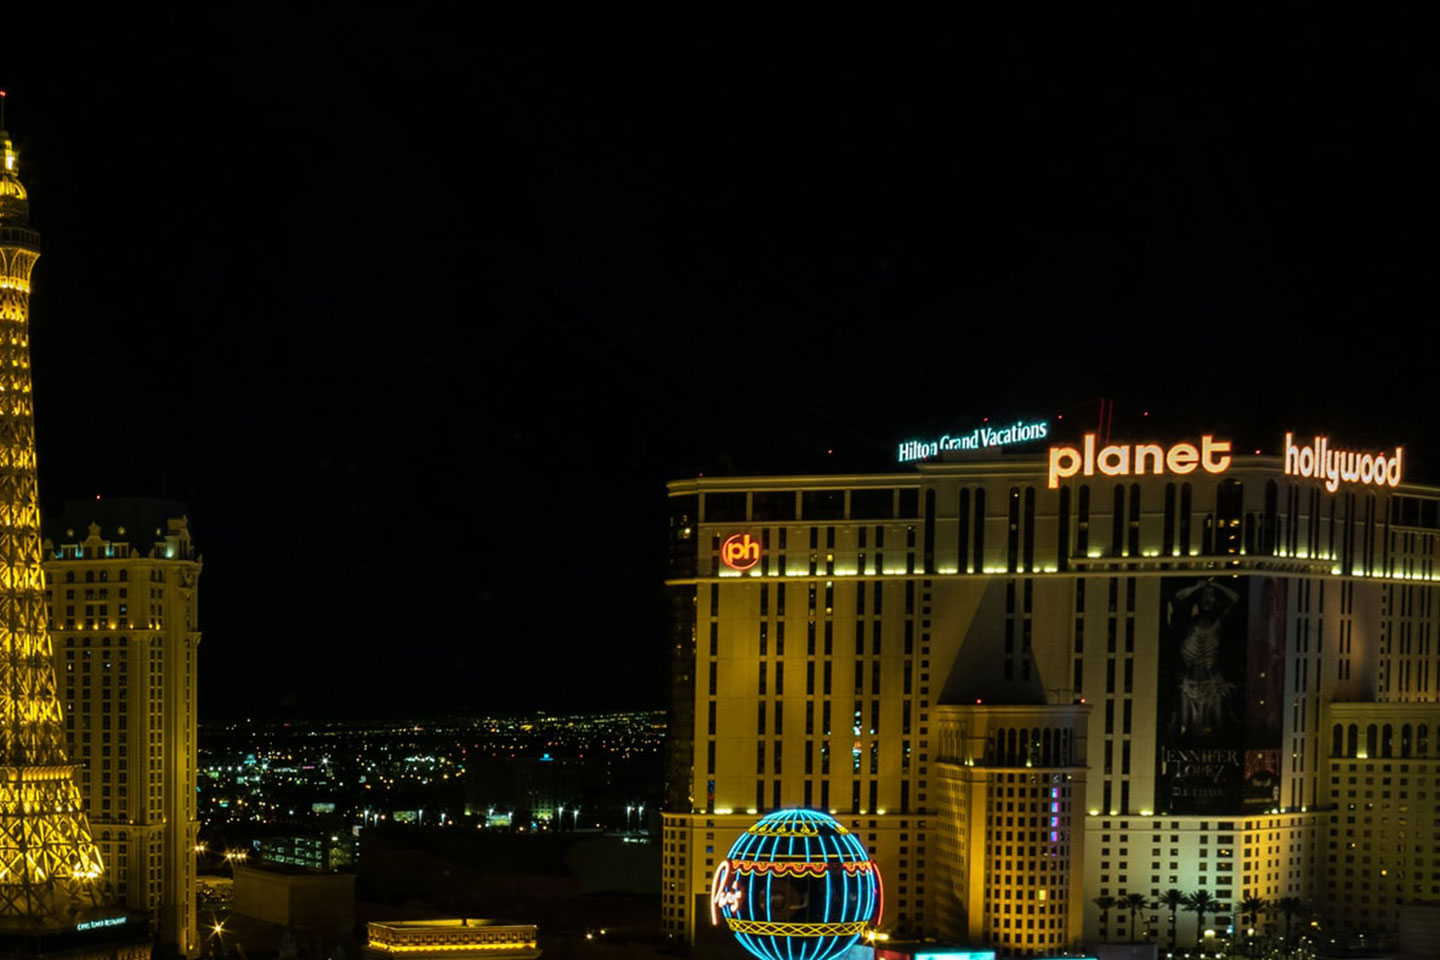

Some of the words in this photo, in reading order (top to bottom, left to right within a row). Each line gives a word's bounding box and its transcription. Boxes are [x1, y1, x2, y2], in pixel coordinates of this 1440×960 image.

[898, 440, 938, 462] Hilton
[939, 429, 979, 450] Grand
[980, 421, 1047, 448] Vacations
[1048, 433, 1232, 488] planet
[1284, 432, 1402, 493] hollywood
[728, 534, 759, 563] ph
